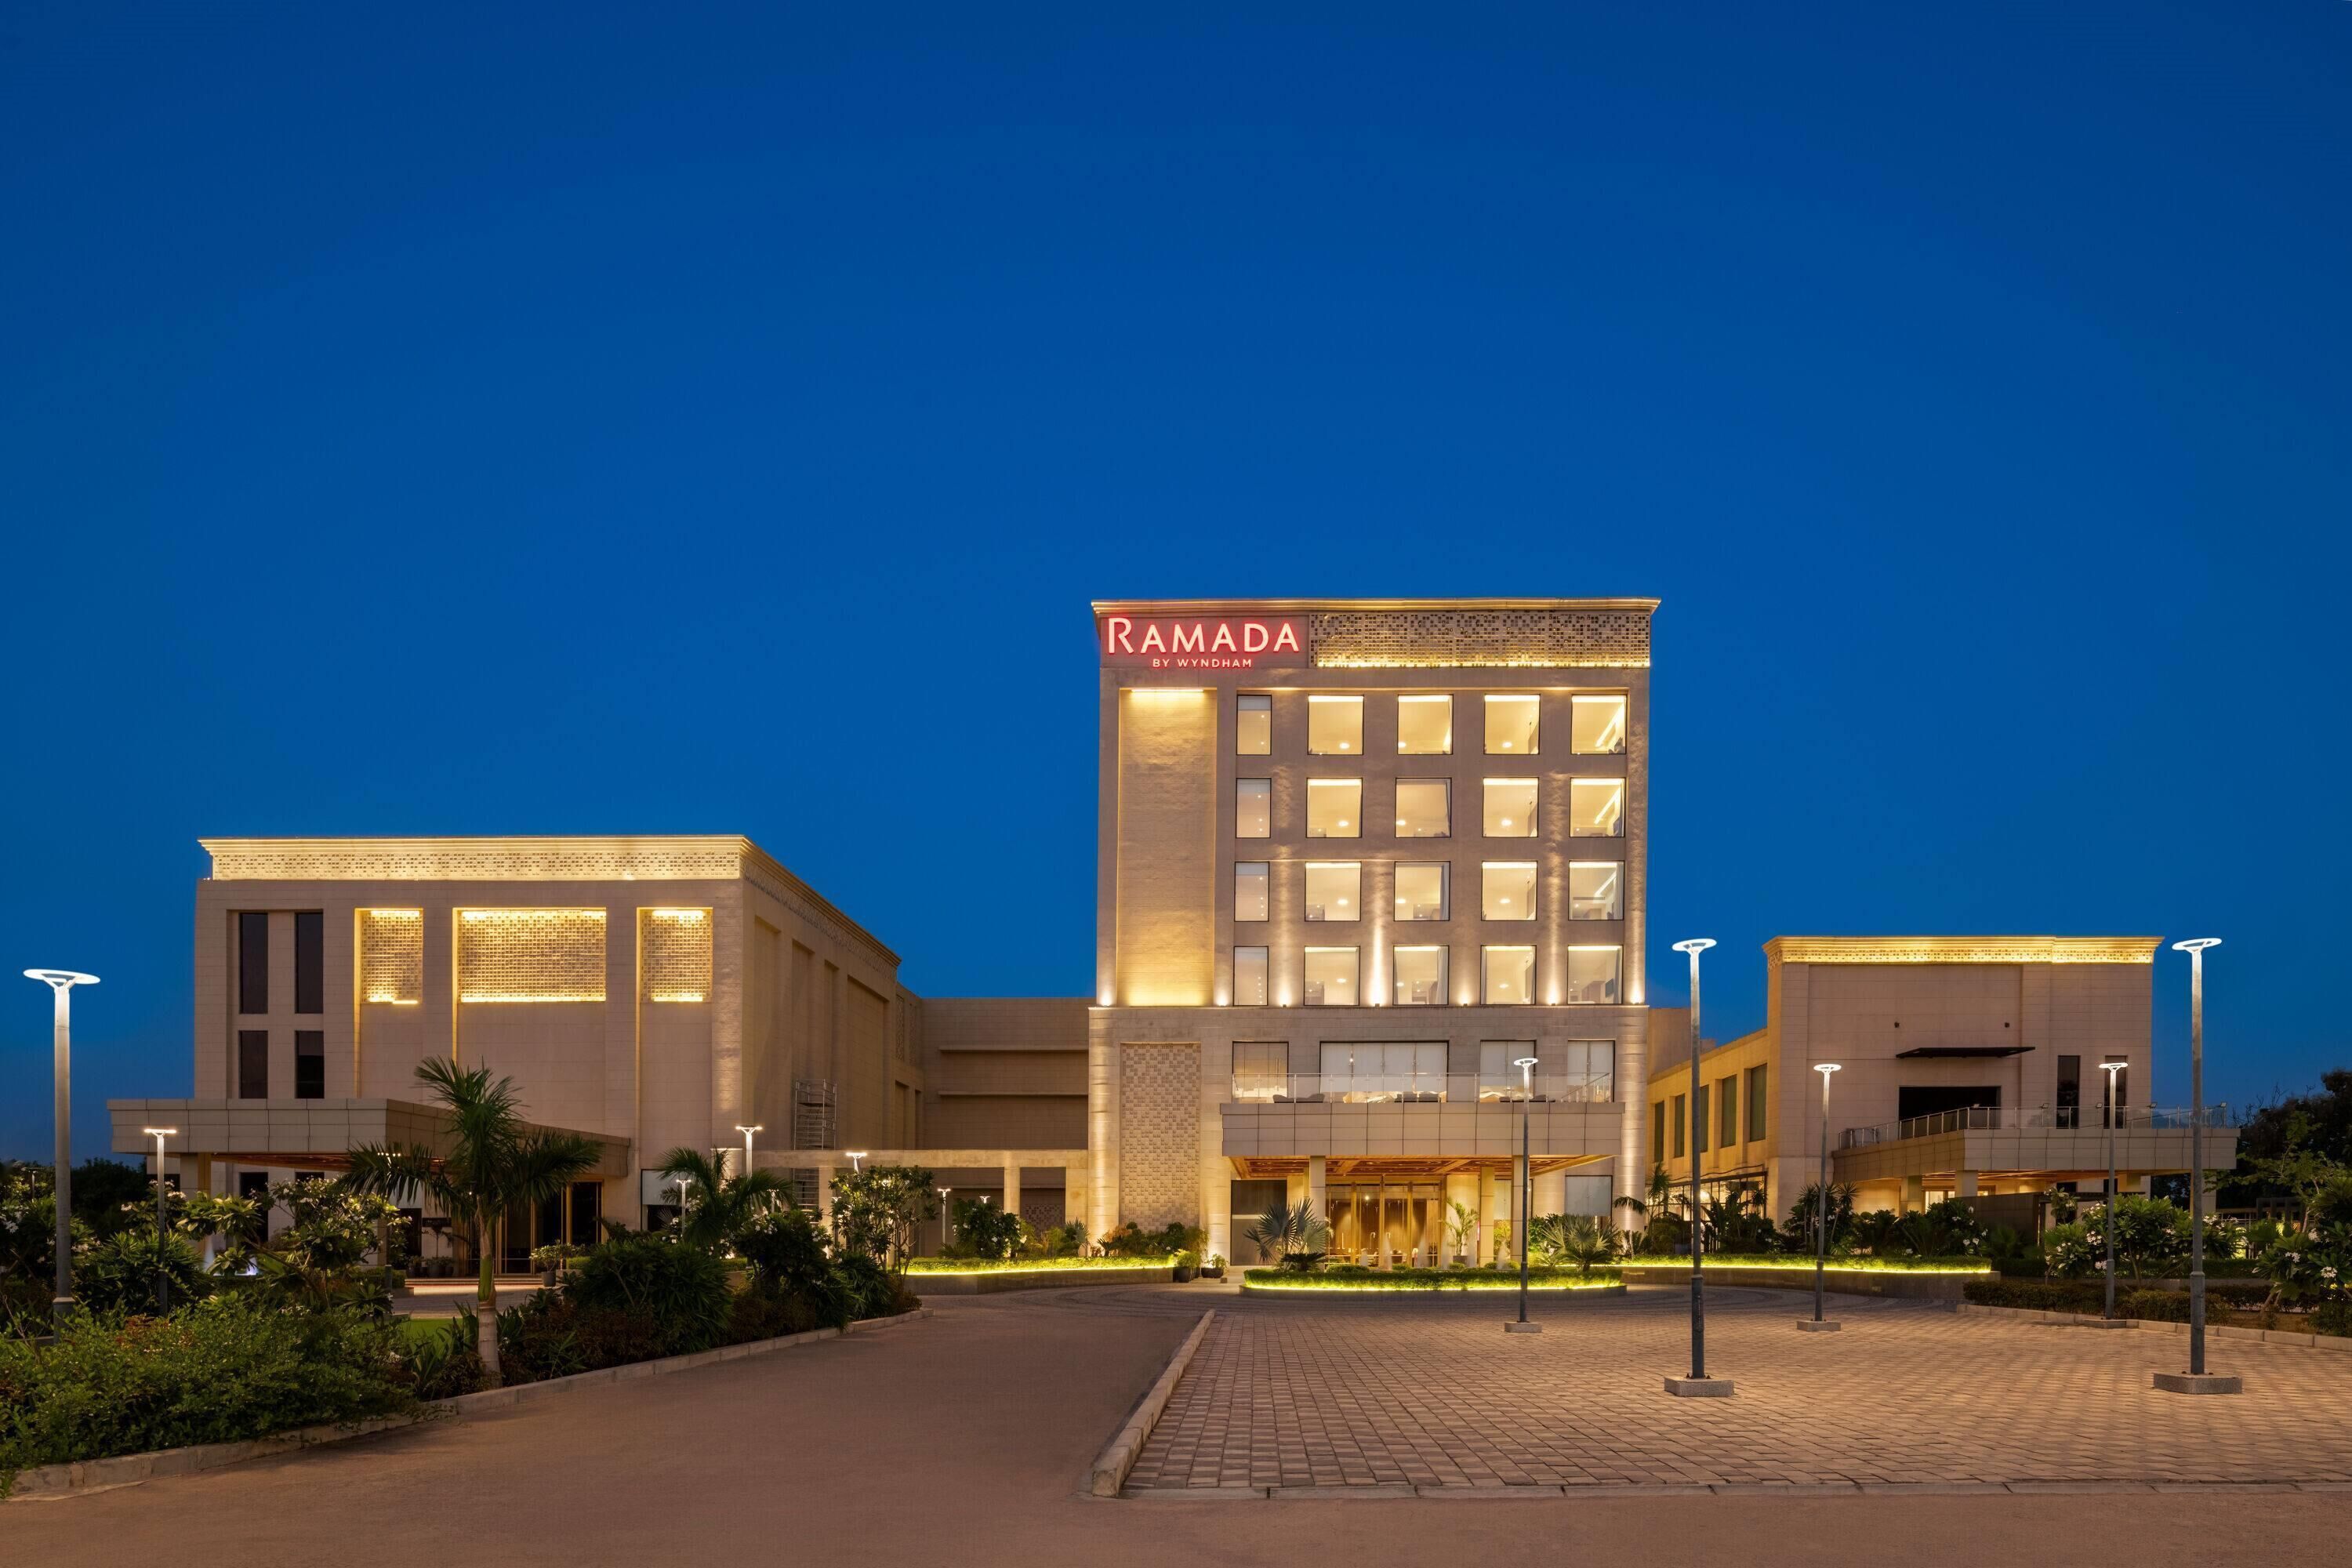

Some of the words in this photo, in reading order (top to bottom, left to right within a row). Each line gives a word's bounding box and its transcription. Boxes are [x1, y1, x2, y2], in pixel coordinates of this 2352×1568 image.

[1109, 617, 1300, 653] RAMADA
[1152, 659, 1170, 667] BY
[1178, 659, 1251, 667] WYNDHAM
